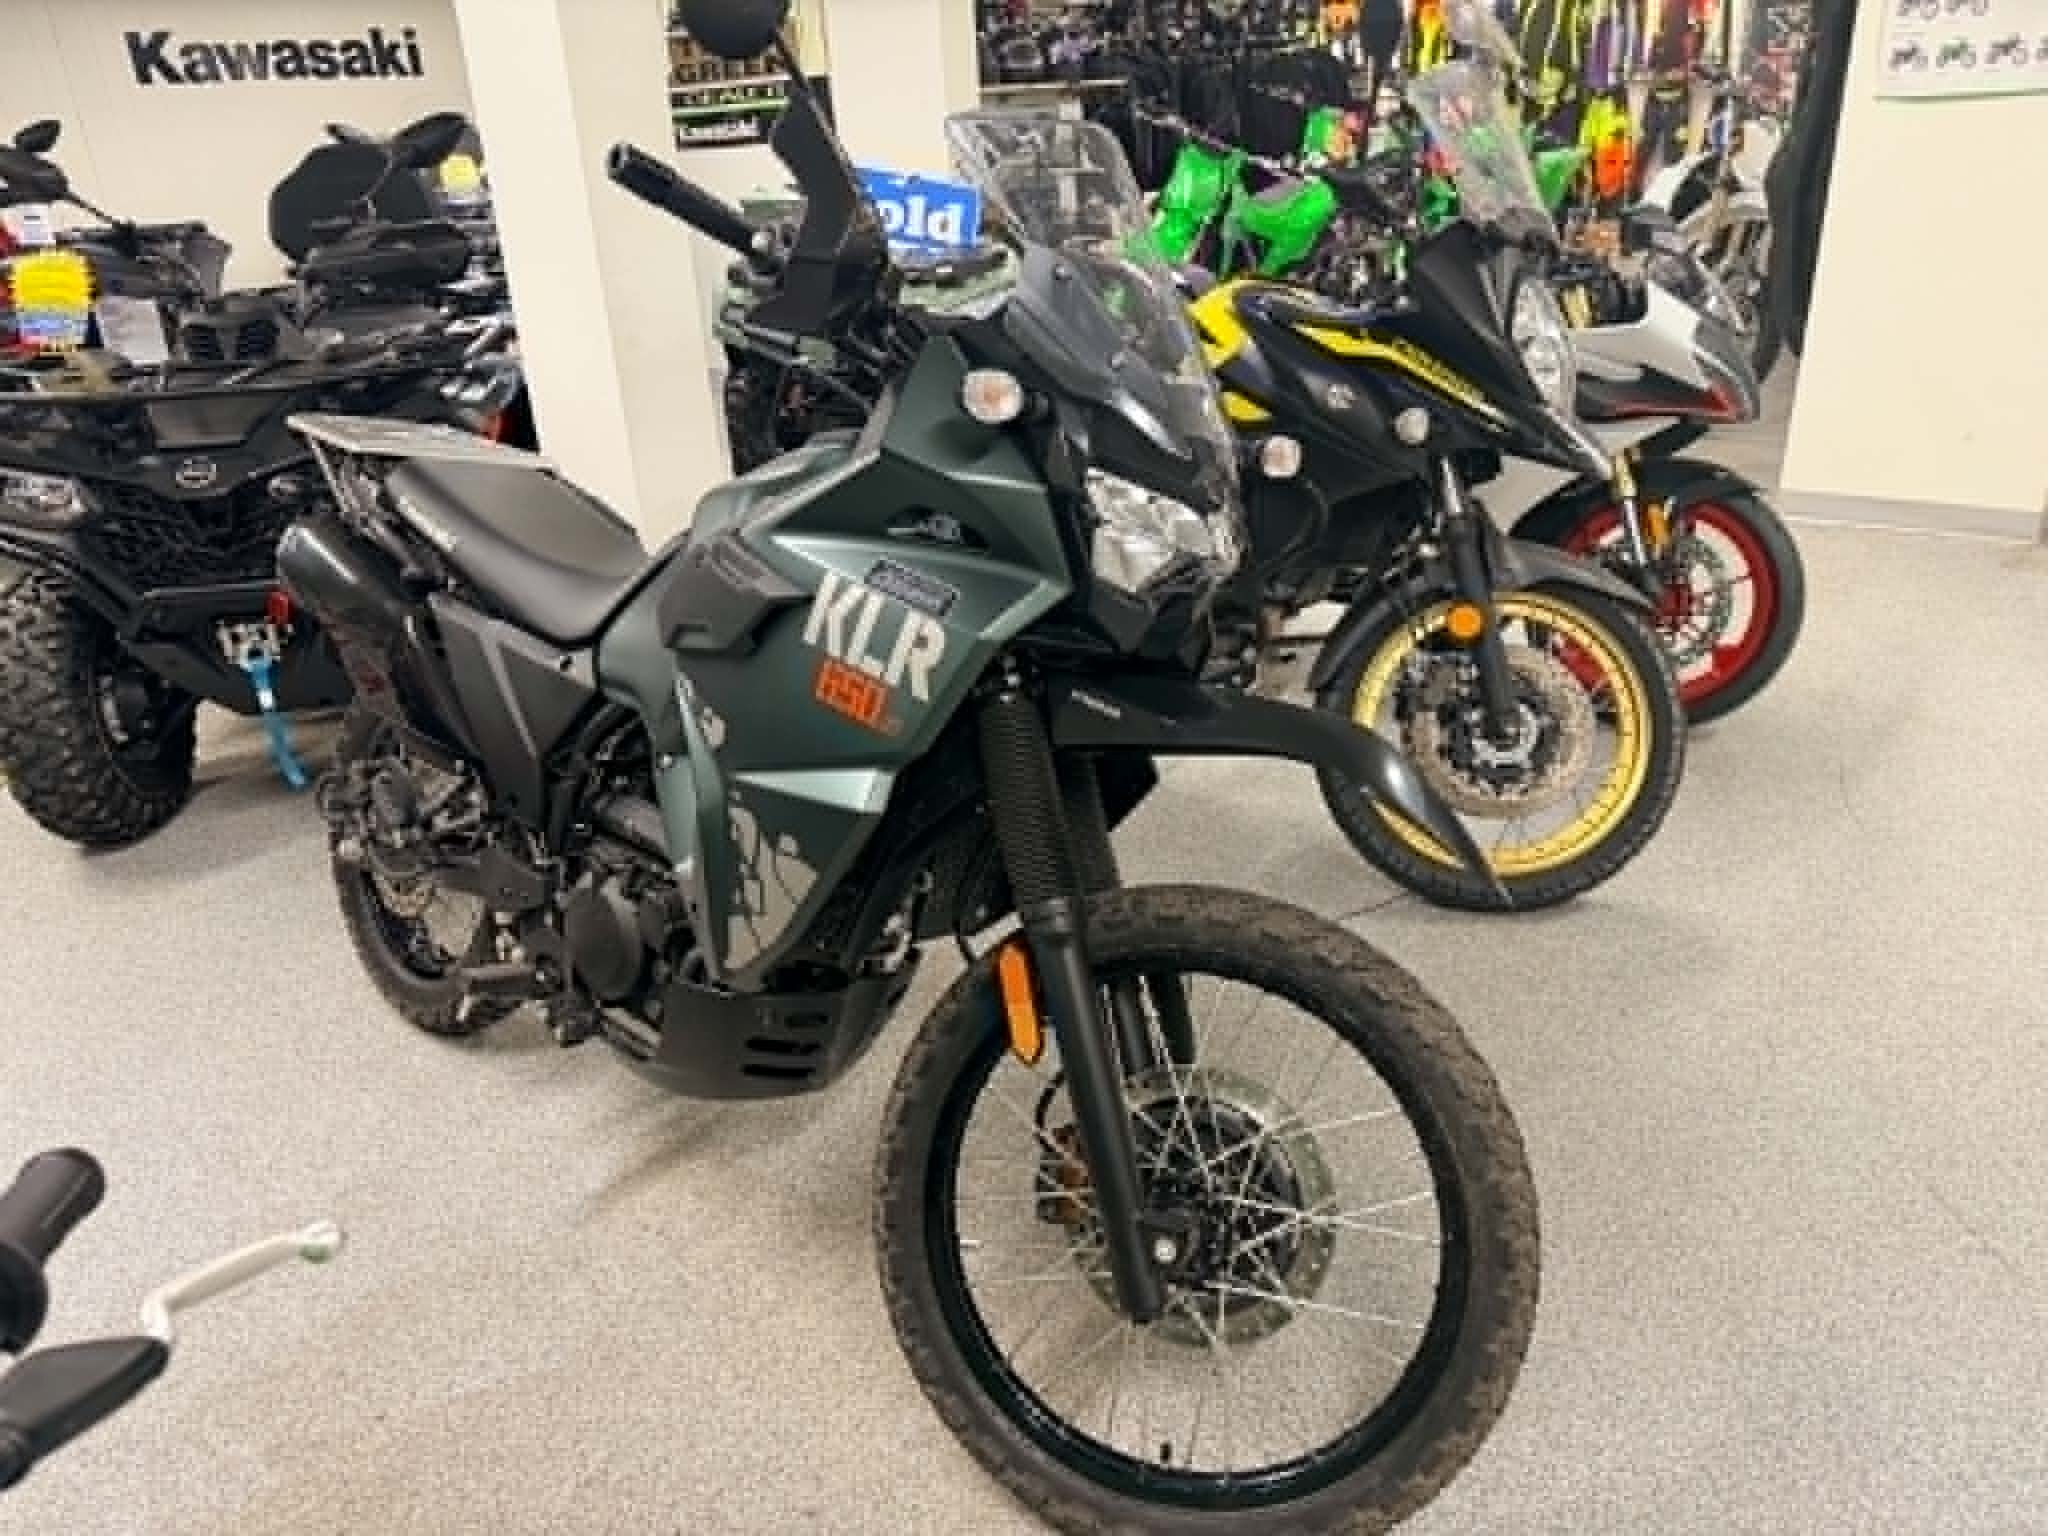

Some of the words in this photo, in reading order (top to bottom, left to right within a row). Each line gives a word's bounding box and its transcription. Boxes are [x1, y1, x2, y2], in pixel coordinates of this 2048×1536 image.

[123, 27, 424, 86] Kawasaki
[876, 195, 963, 245] old
[802, 568, 946, 703] KLR
